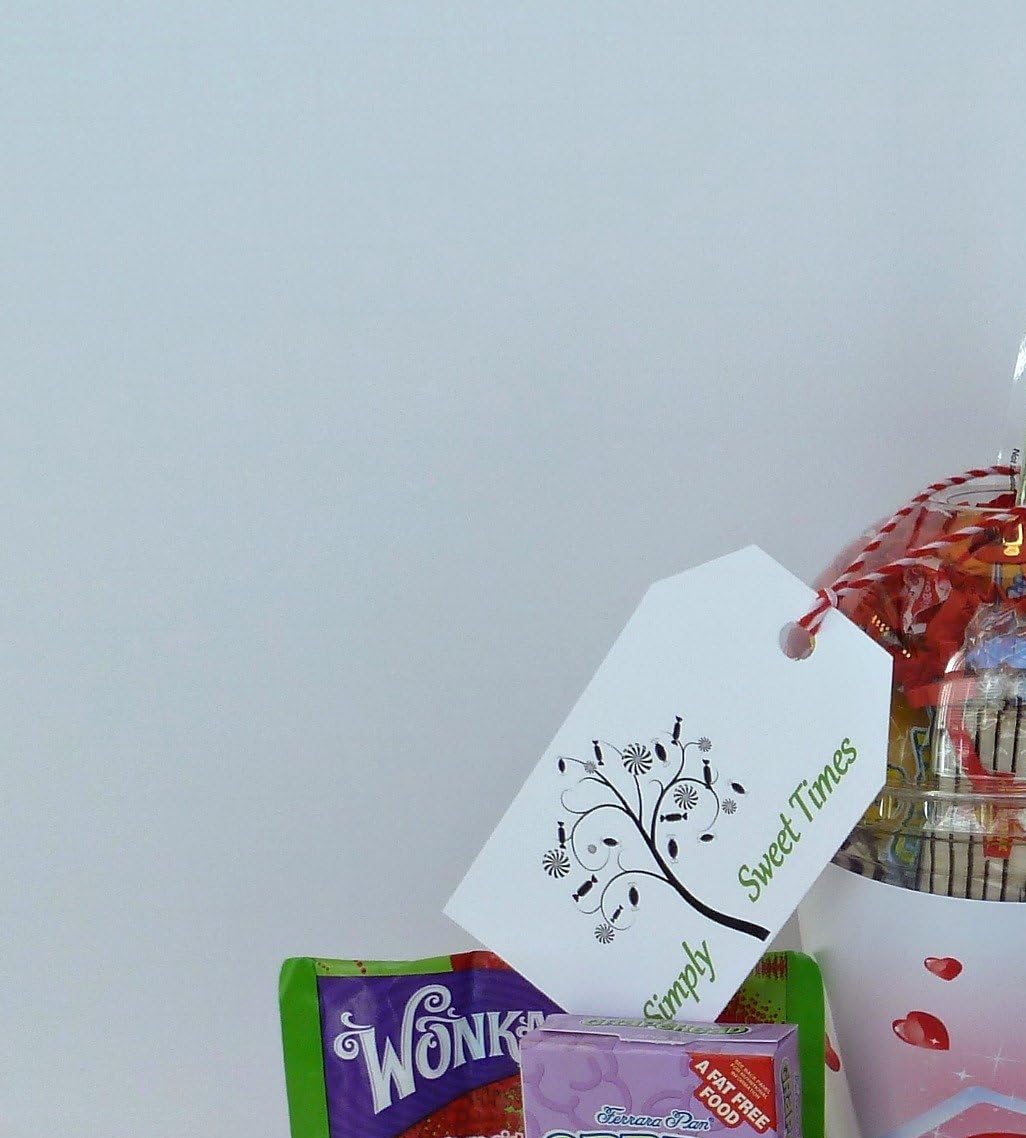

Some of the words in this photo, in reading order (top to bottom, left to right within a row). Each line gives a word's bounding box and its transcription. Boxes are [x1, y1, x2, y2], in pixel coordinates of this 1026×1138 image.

[642, 940, 717, 1022] Simply
[738, 813, 802, 904] Sweet
[788, 737, 858, 824] Times
[597, 1107, 662, 1129] Ferrara
[695, 1060, 709, 1077] A
[707, 1069, 733, 1094] FAT
[732, 1092, 771, 1130] FREE
[700, 1086, 741, 1126] FOOD
